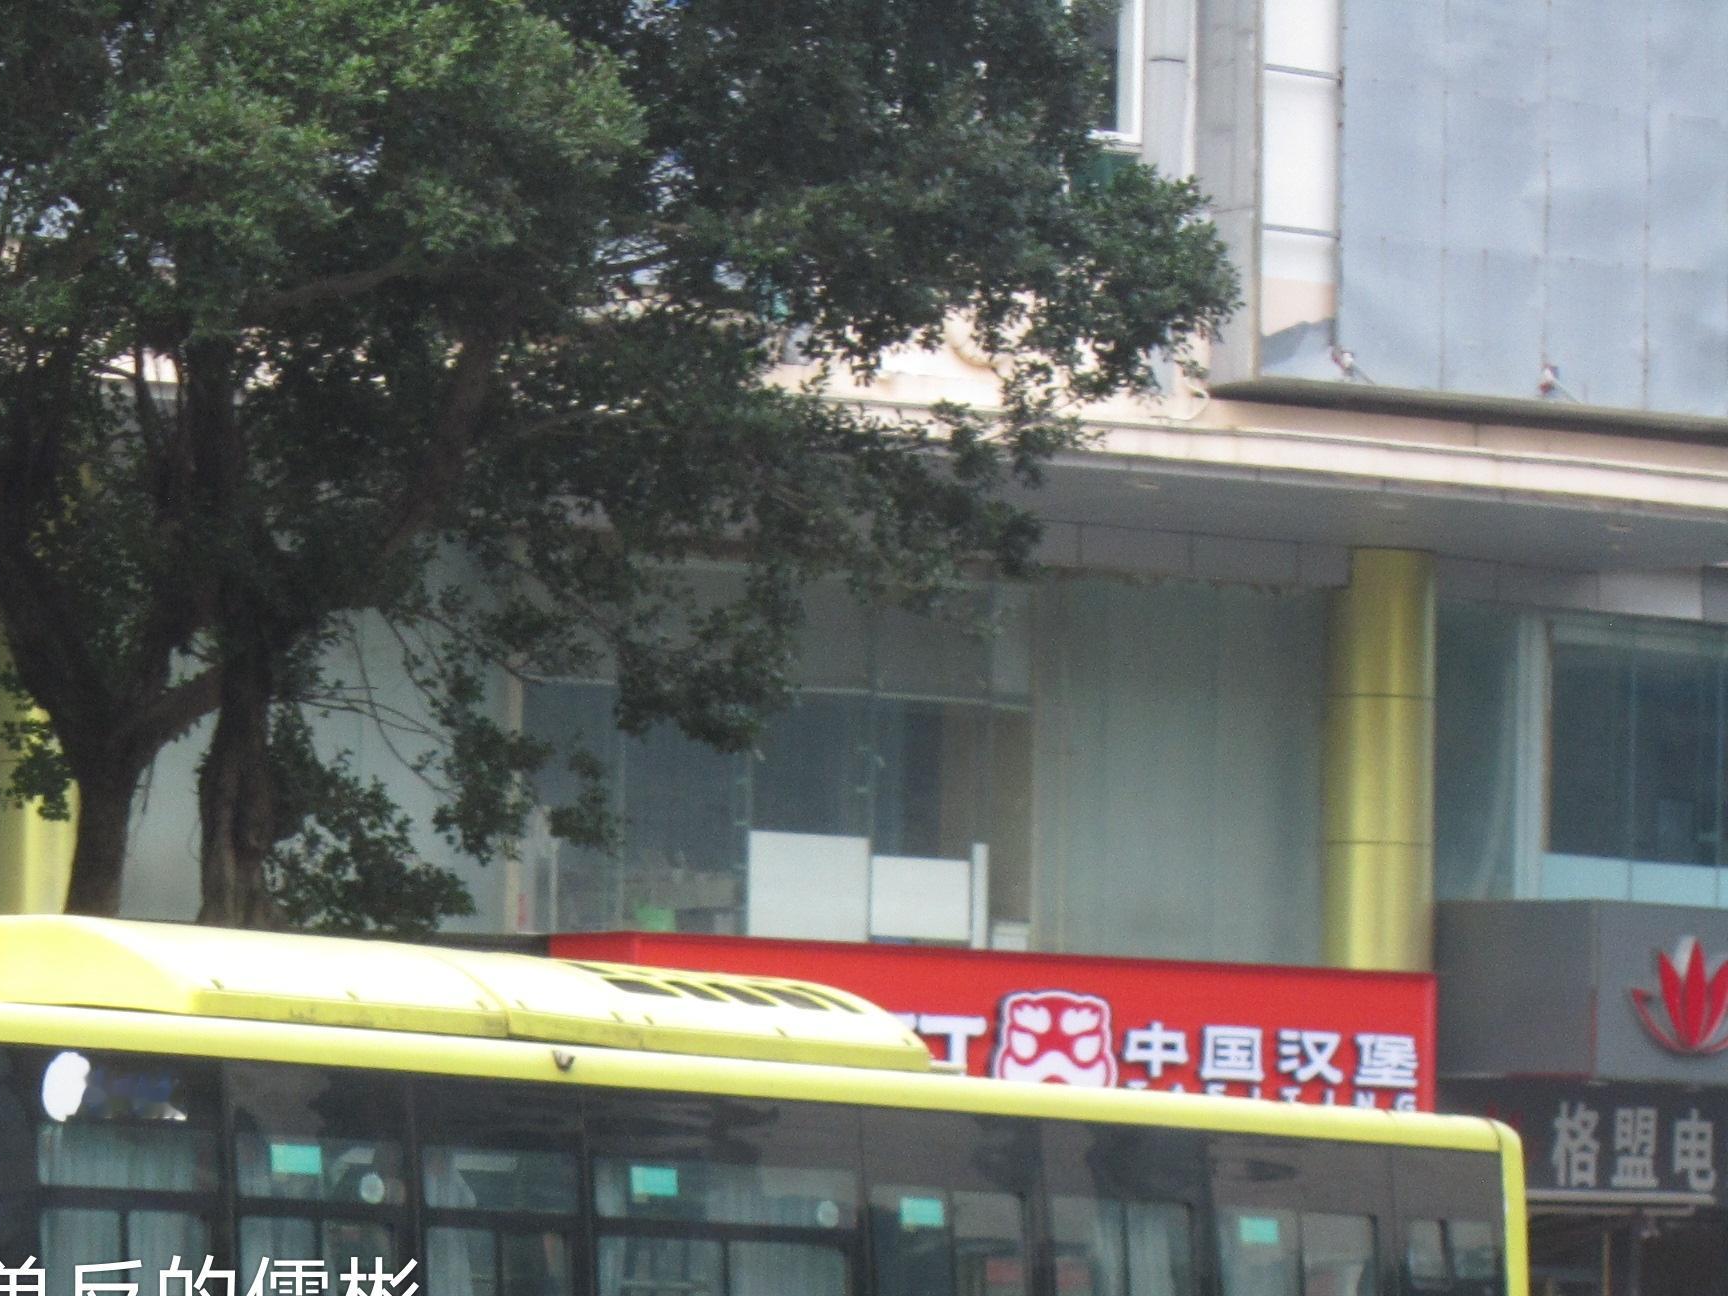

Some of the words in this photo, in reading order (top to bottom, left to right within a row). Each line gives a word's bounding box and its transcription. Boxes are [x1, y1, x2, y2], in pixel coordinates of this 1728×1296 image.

[1122, 1021, 1419, 1088] 中国汉堡
[1551, 1101, 1718, 1193] 格盟电
